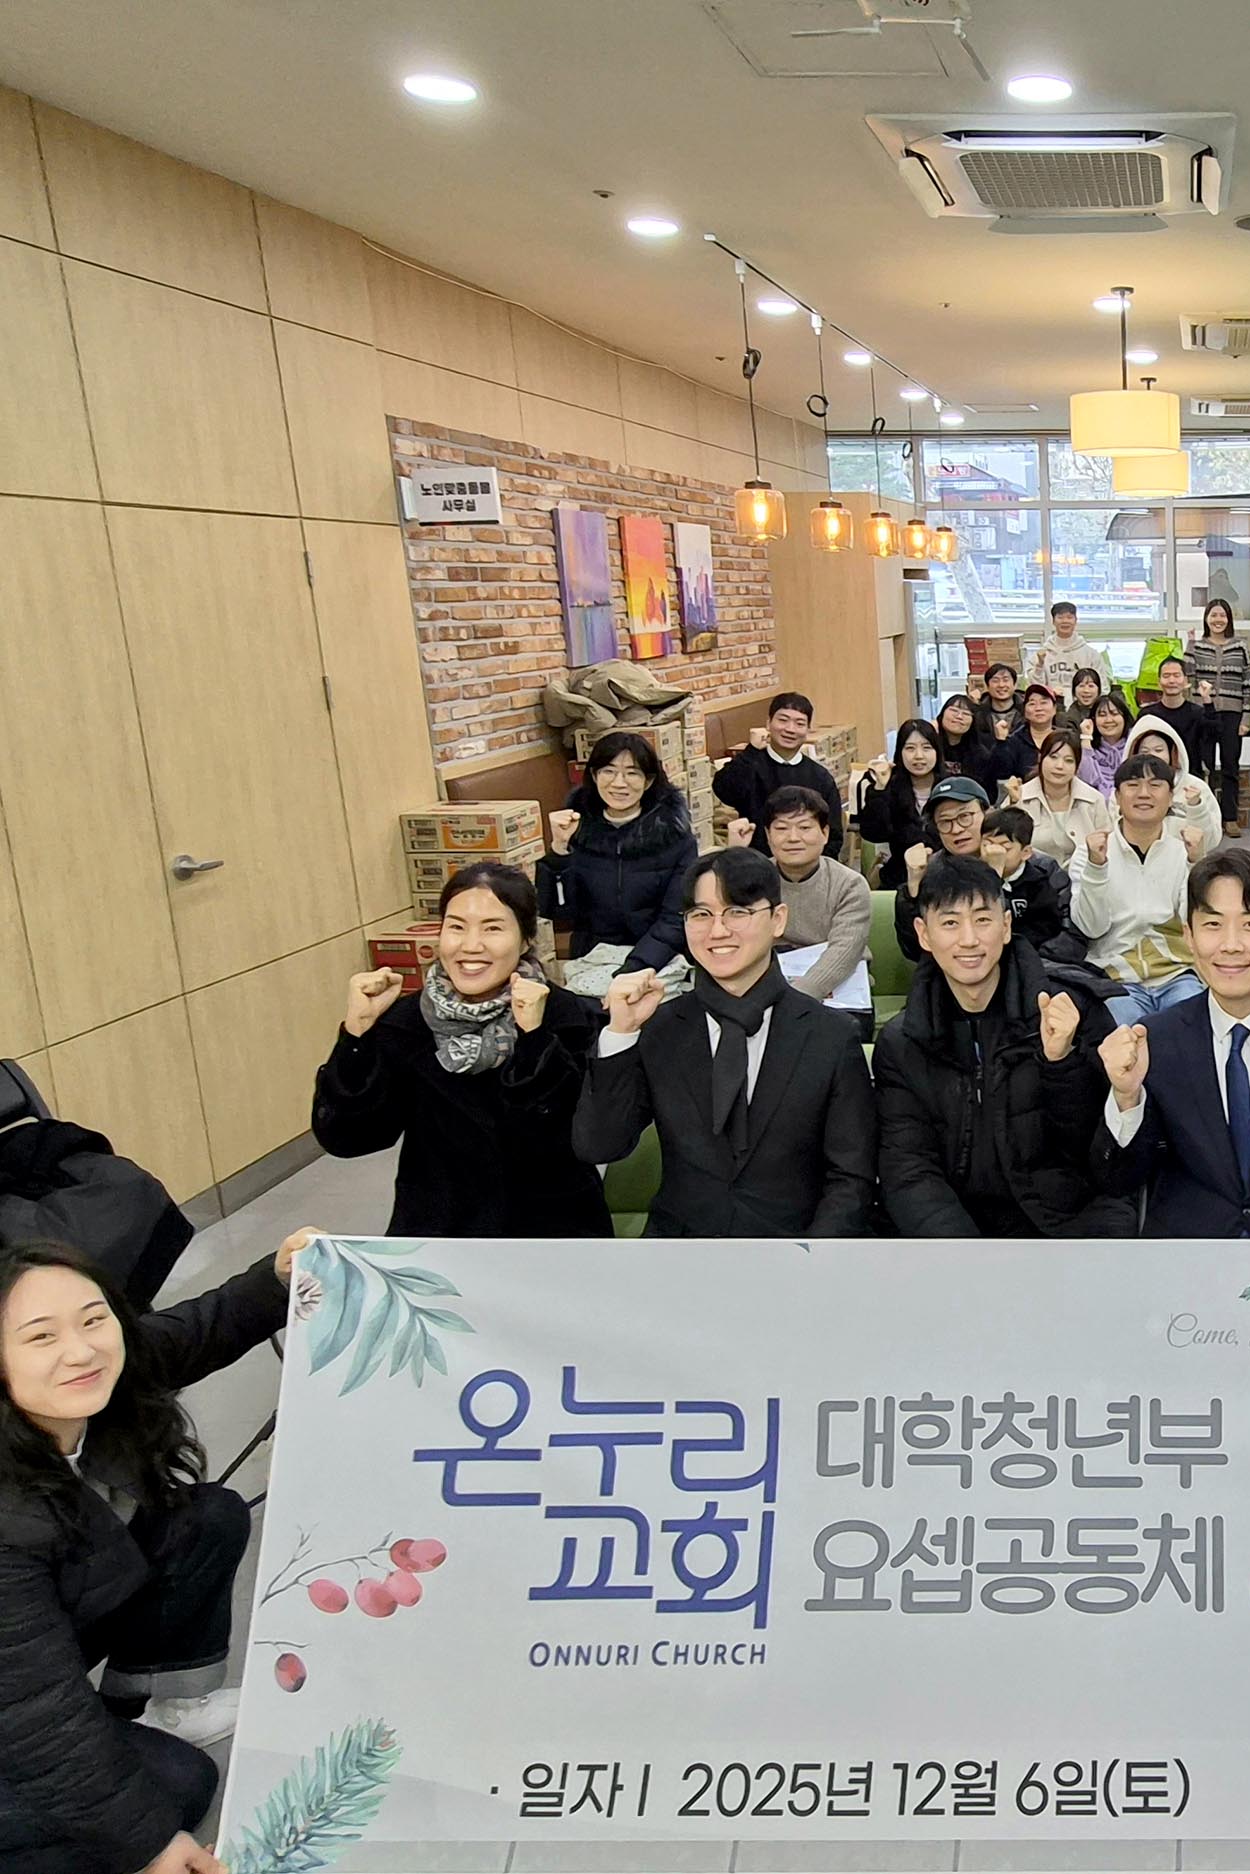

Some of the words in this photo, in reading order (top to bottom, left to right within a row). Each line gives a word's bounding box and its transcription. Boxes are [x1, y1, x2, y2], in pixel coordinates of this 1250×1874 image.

[442, 499, 477, 513] 사무실
[1166, 1312, 1239, 1348] Come,
[412, 1366, 781, 1507] 온누리
[815, 1391, 1230, 1490] 대학청년부
[528, 1502, 777, 1630] 교회
[803, 1512, 1226, 1615] 요셉공동체
[528, 1640, 640, 1668] ONNURI
[651, 1640, 767, 1668] CHURCH
[677, 1760, 874, 1818] 2025년
[892, 1760, 998, 1818] 12월
[1015, 1758, 1190, 1818] 6일(토)
